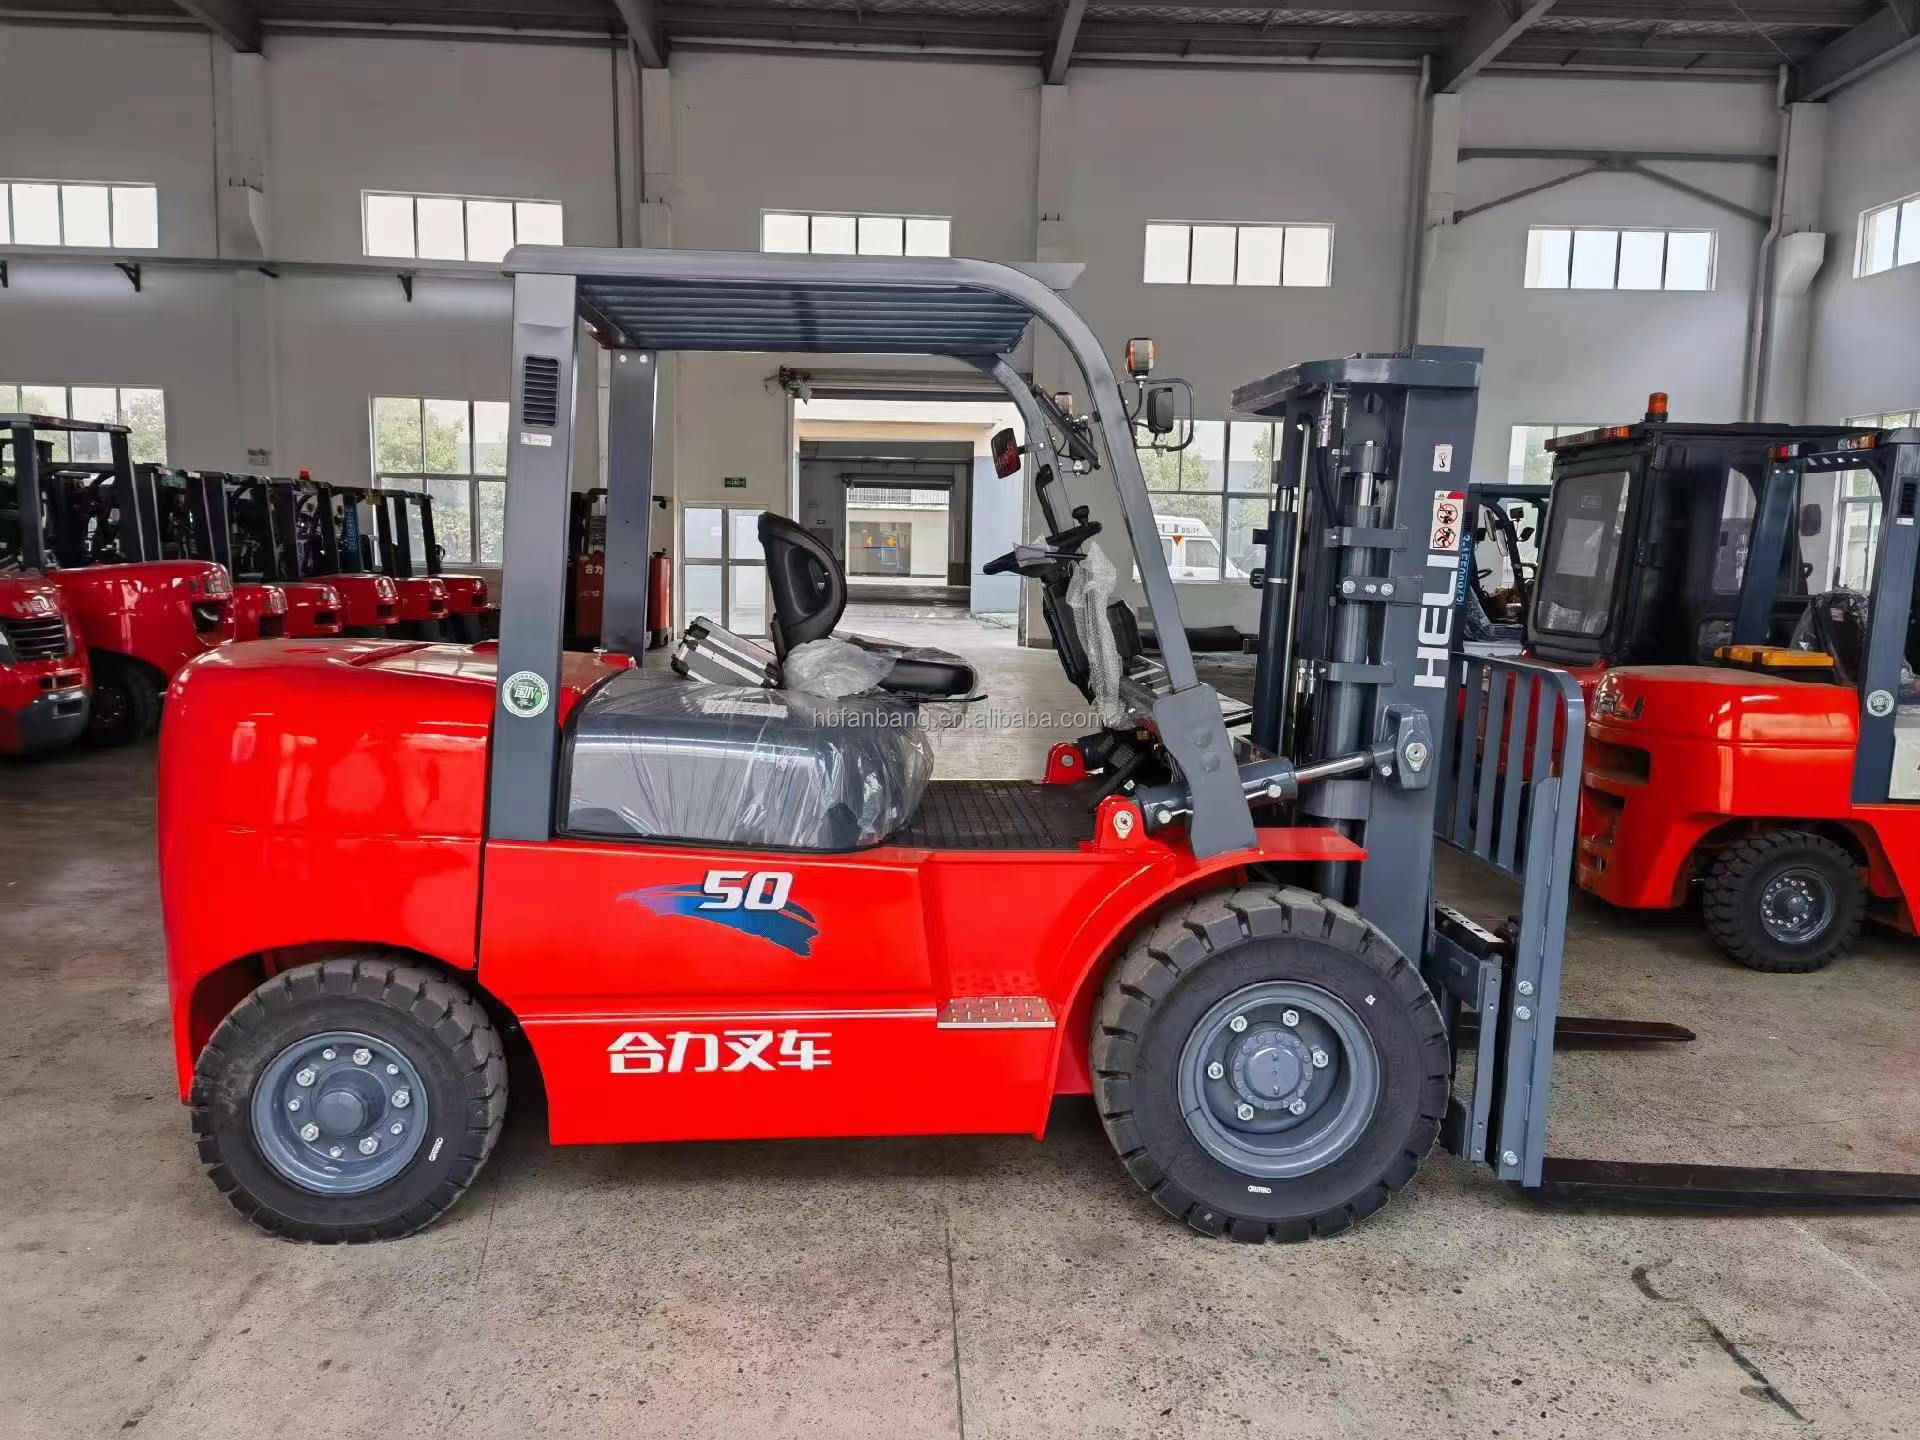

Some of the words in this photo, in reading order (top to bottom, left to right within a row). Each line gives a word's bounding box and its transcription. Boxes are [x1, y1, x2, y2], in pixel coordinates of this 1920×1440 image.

[585, 564, 603, 574] 合力
[1414, 554, 1459, 688] HELI
[698, 870, 794, 911] 50
[607, 1029, 832, 1074] 合力叉车
